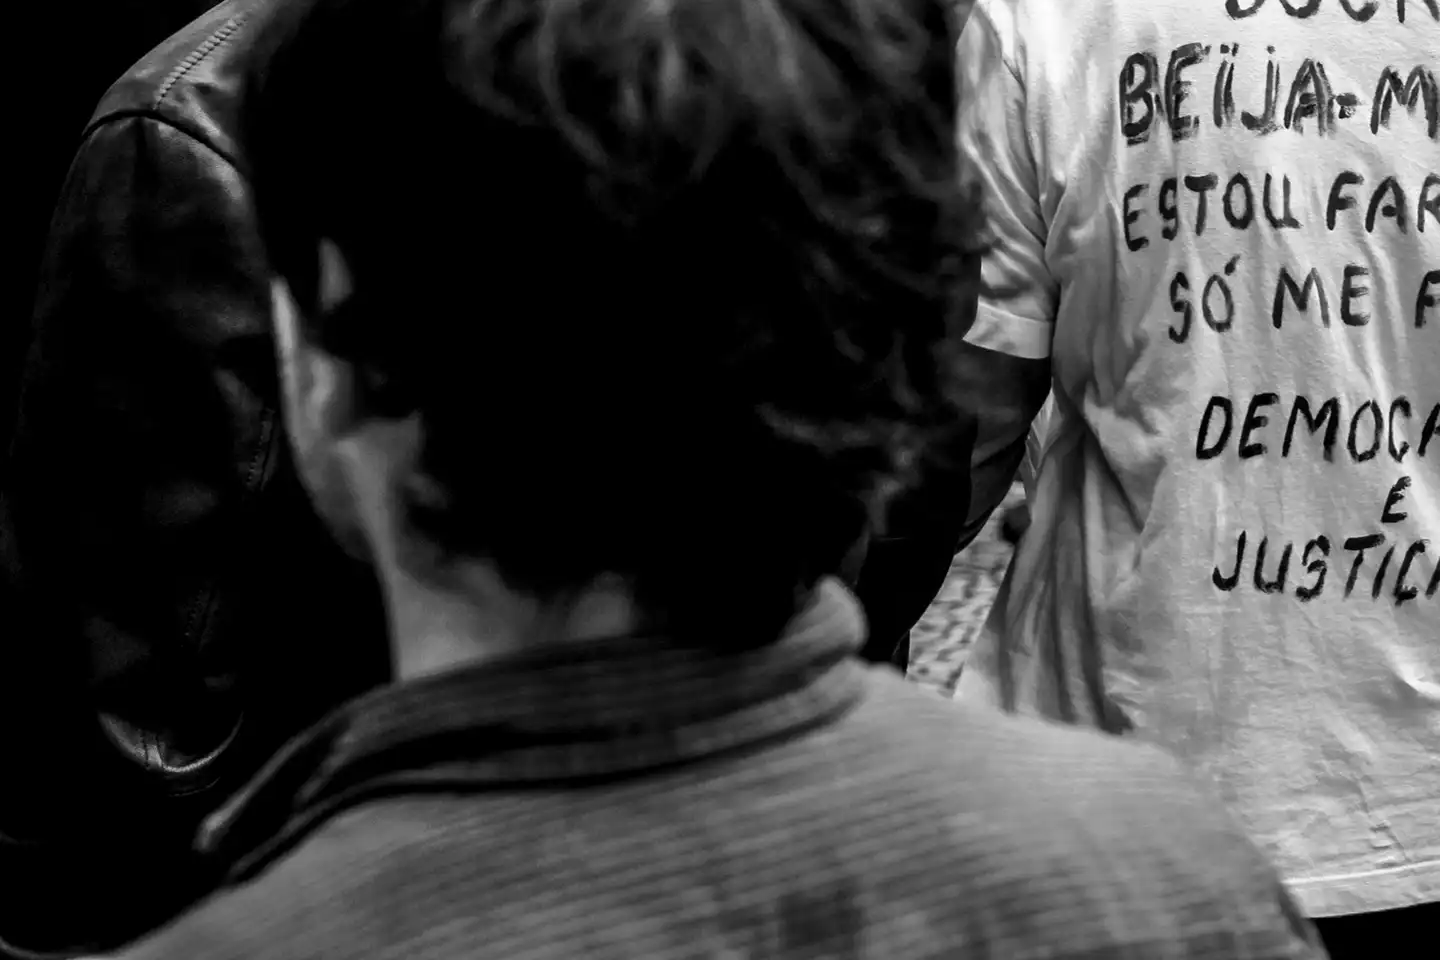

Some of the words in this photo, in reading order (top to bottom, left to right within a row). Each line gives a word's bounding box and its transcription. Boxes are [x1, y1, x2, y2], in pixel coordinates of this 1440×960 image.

[1122, 171, 1300, 250] ESTOU
[1168, 254, 1240, 342] SÓ
[1271, 263, 1371, 328] ME
[1380, 476, 1412, 523] E
